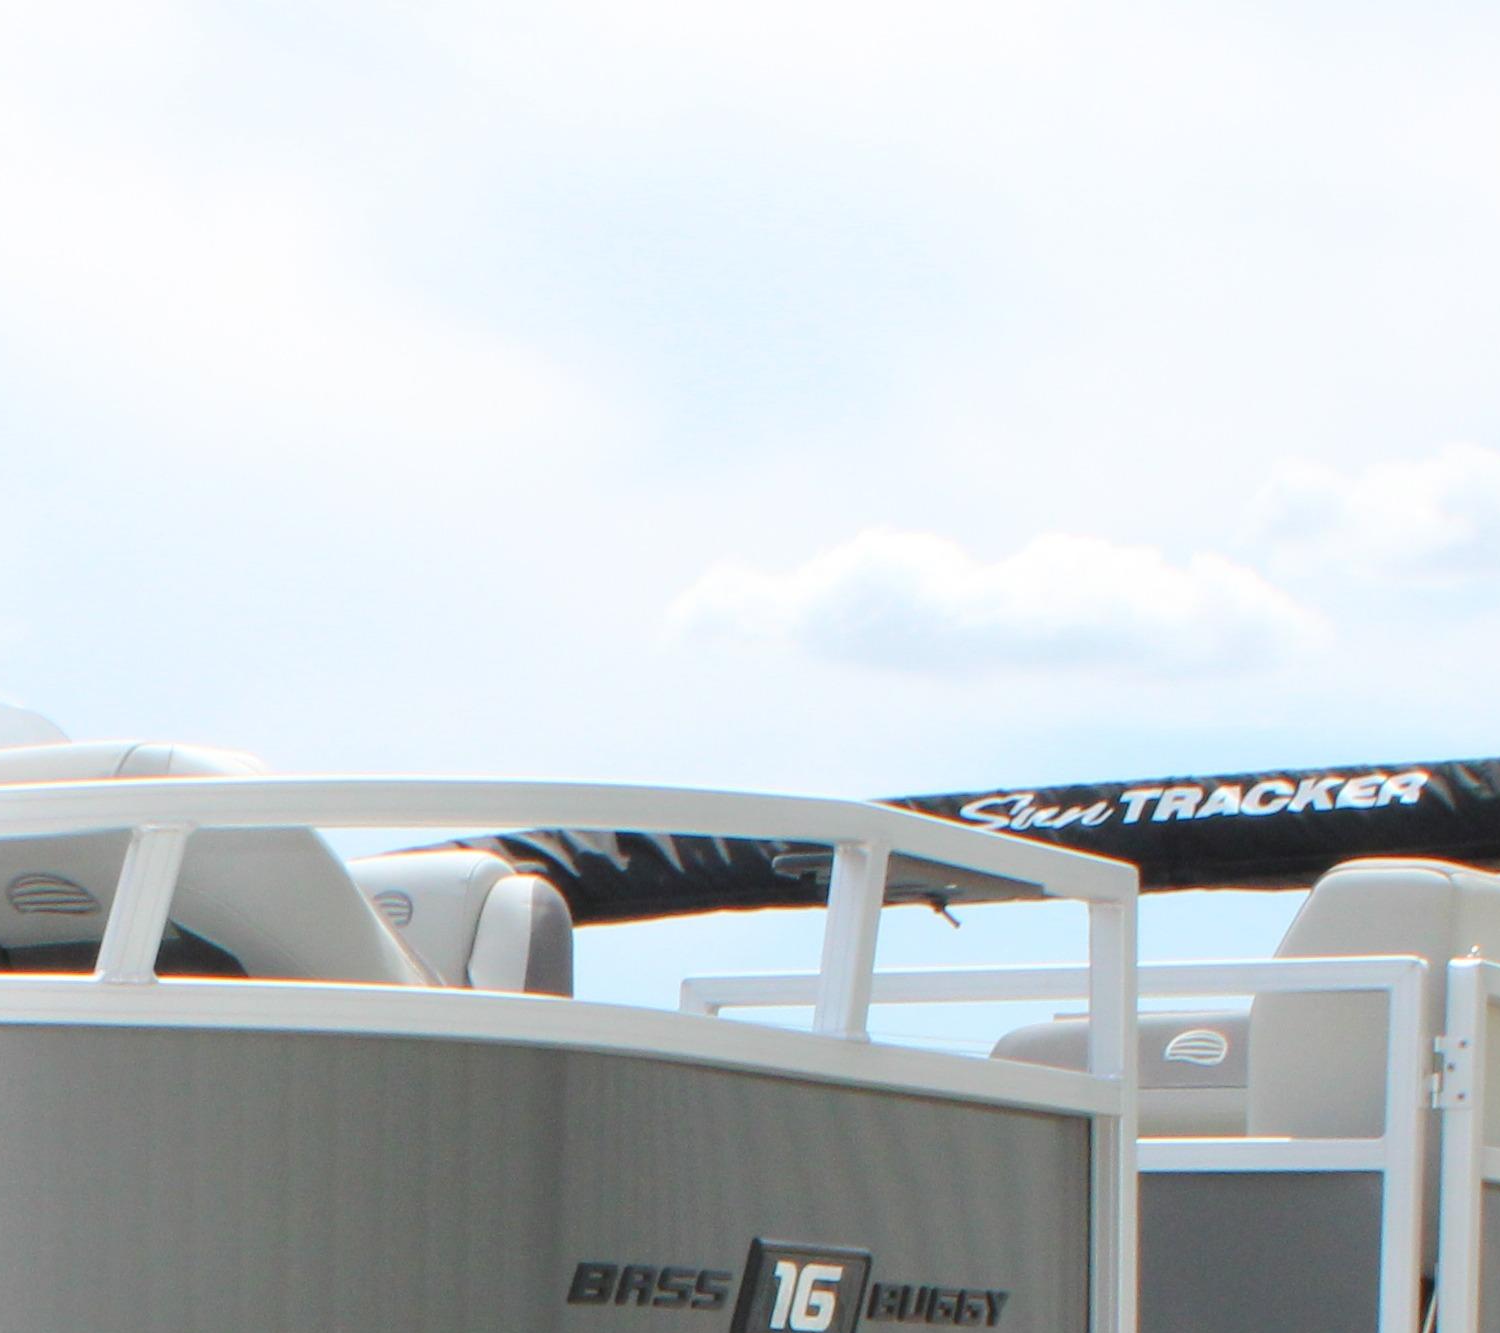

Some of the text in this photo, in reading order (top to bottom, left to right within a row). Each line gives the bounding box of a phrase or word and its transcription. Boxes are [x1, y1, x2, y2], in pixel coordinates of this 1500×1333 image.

[959, 769, 1430, 831] Sun TRACKER
[567, 1259, 1010, 1333] BASS 16 BUGGY
